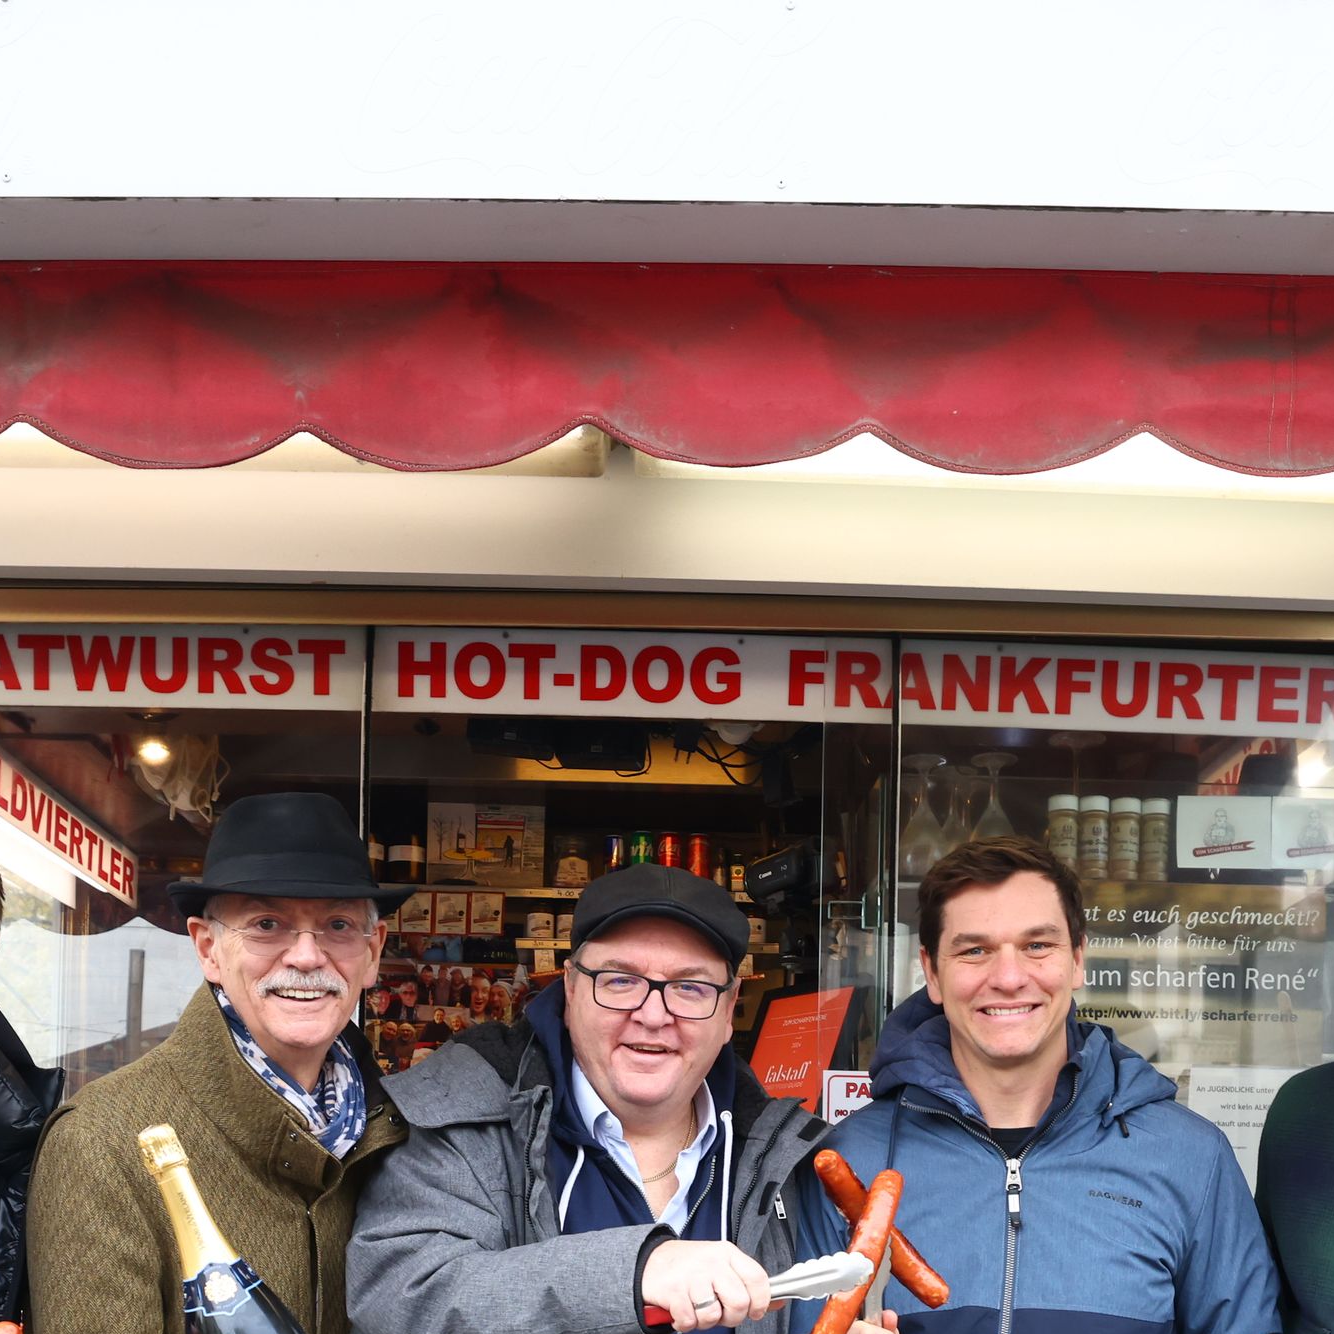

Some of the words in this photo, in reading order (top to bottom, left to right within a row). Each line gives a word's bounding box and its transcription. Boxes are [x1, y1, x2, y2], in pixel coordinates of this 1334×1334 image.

[397, 640, 742, 706] HOT-DOG
[1083, 906, 1100, 923] at
[1107, 909, 1126, 922] es
[1132, 905, 1181, 924] euch
[1185, 906, 1321, 929] geschmeckt!?
[1131, 932, 1180, 949] Votet
[1186, 934, 1227, 951] bitte
[1228, 934, 1261, 956] für
[1266, 939, 1297, 953] uns
[1083, 969, 1122, 987] um
[1130, 964, 1236, 989] scharfen
[764, 1060, 812, 1083] falstaff
[845, 1082, 873, 1099] PA
[1196, 1085, 1206, 1093] An
[1207, 1085, 1254, 1093] JUGENDLICHE
[1237, 1120, 1251, 1128] und
